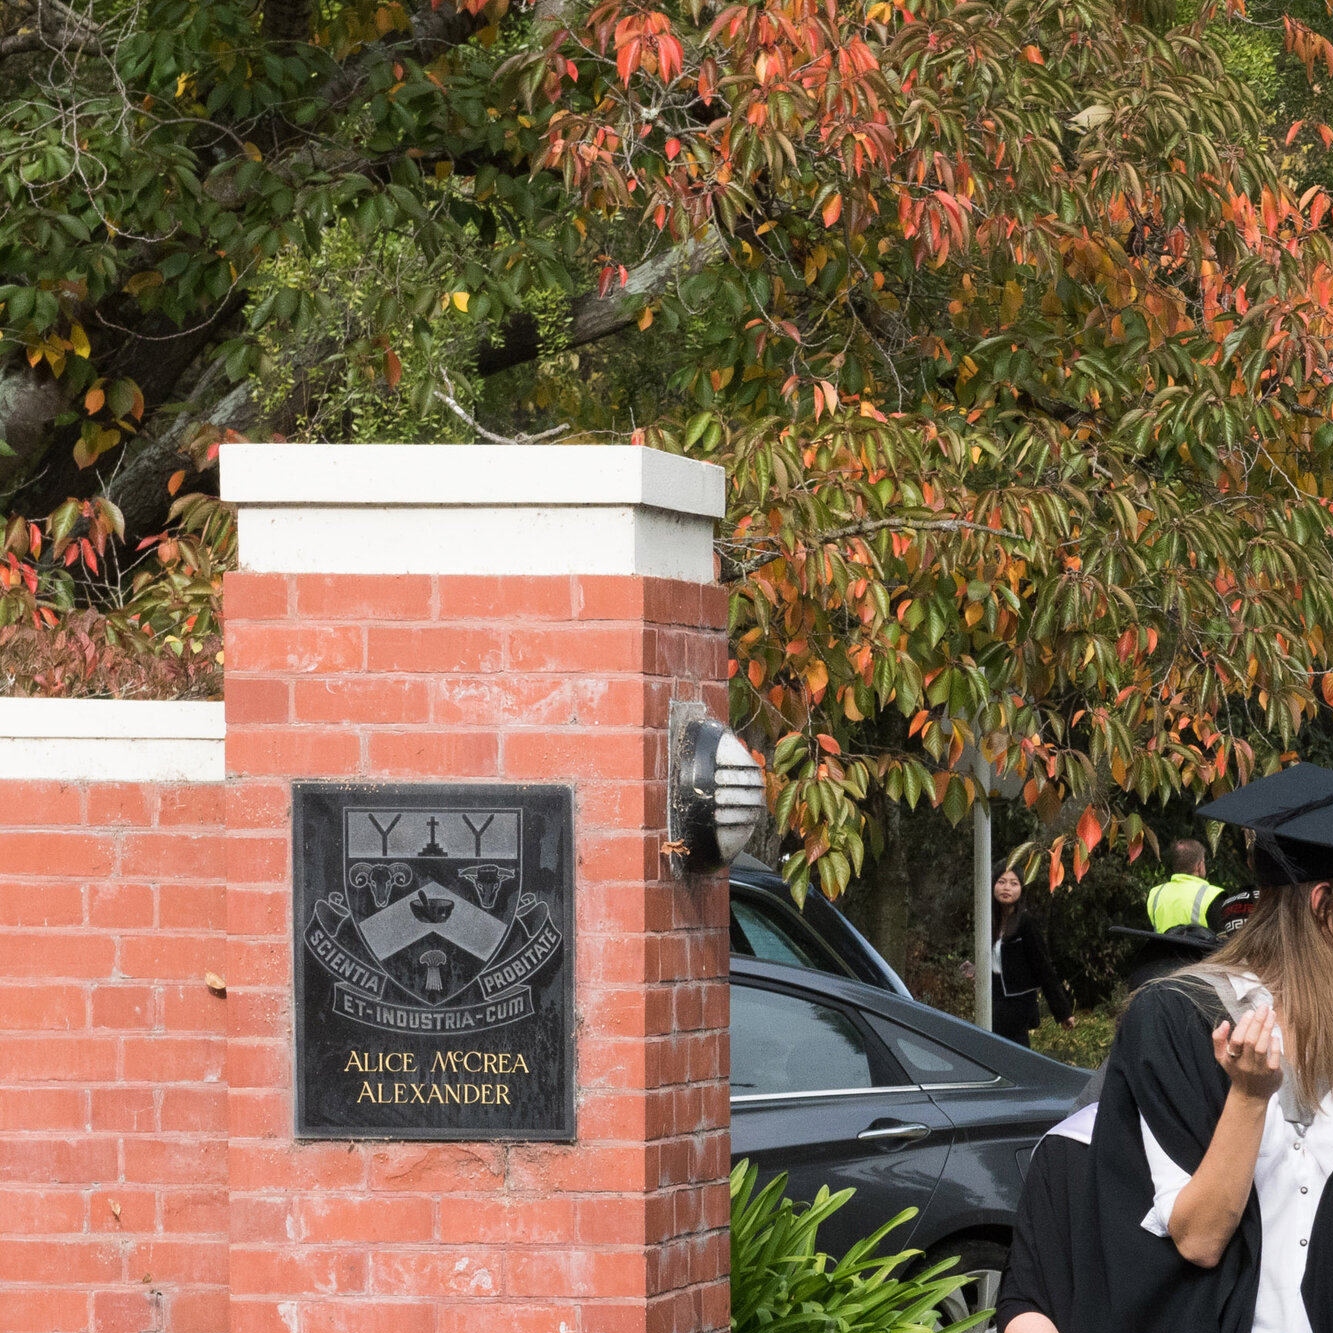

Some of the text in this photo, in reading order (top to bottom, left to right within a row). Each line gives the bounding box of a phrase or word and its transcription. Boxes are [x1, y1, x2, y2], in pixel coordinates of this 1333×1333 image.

[310, 929, 379, 993] SCIENTIA
[484, 927, 557, 993] PROBITATE
[344, 1050, 418, 1072] ALICE
[356, 1080, 511, 1104] ALEXANDER
